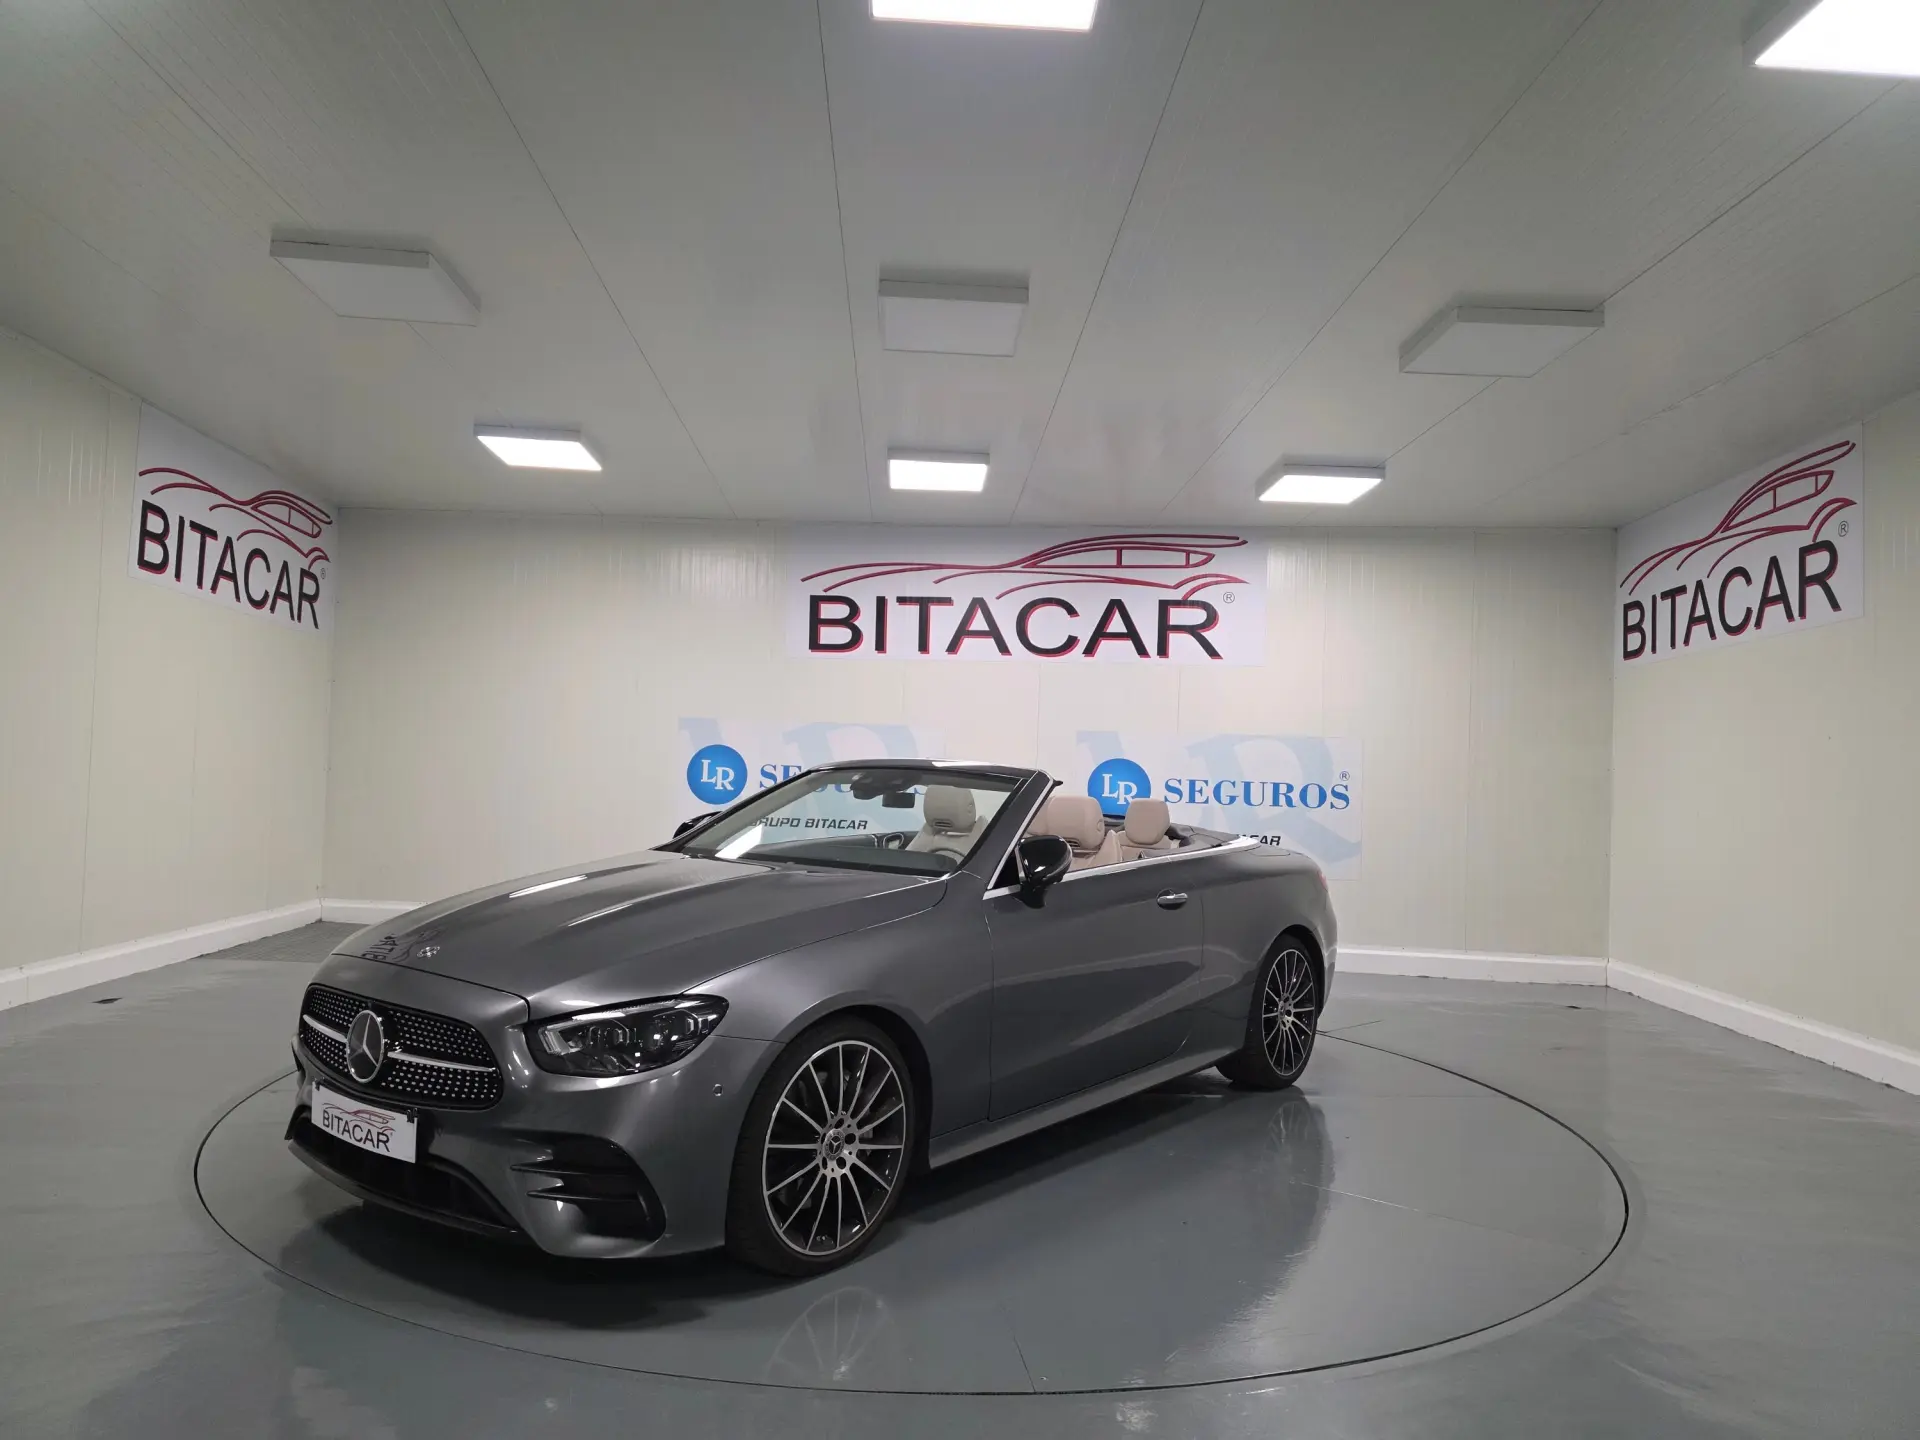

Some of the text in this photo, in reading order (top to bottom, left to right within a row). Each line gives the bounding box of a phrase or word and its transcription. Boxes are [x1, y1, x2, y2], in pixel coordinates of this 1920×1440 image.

[137, 500, 320, 630] BITACAR
[1623, 539, 1842, 661] BITACAR
[808, 594, 1223, 660] BITACAR
[701, 759, 735, 791] LR
[1101, 773, 1350, 810] LR SEGUROS
[804, 818, 868, 830] BITACAR
[322, 1109, 391, 1153] BITACAR
